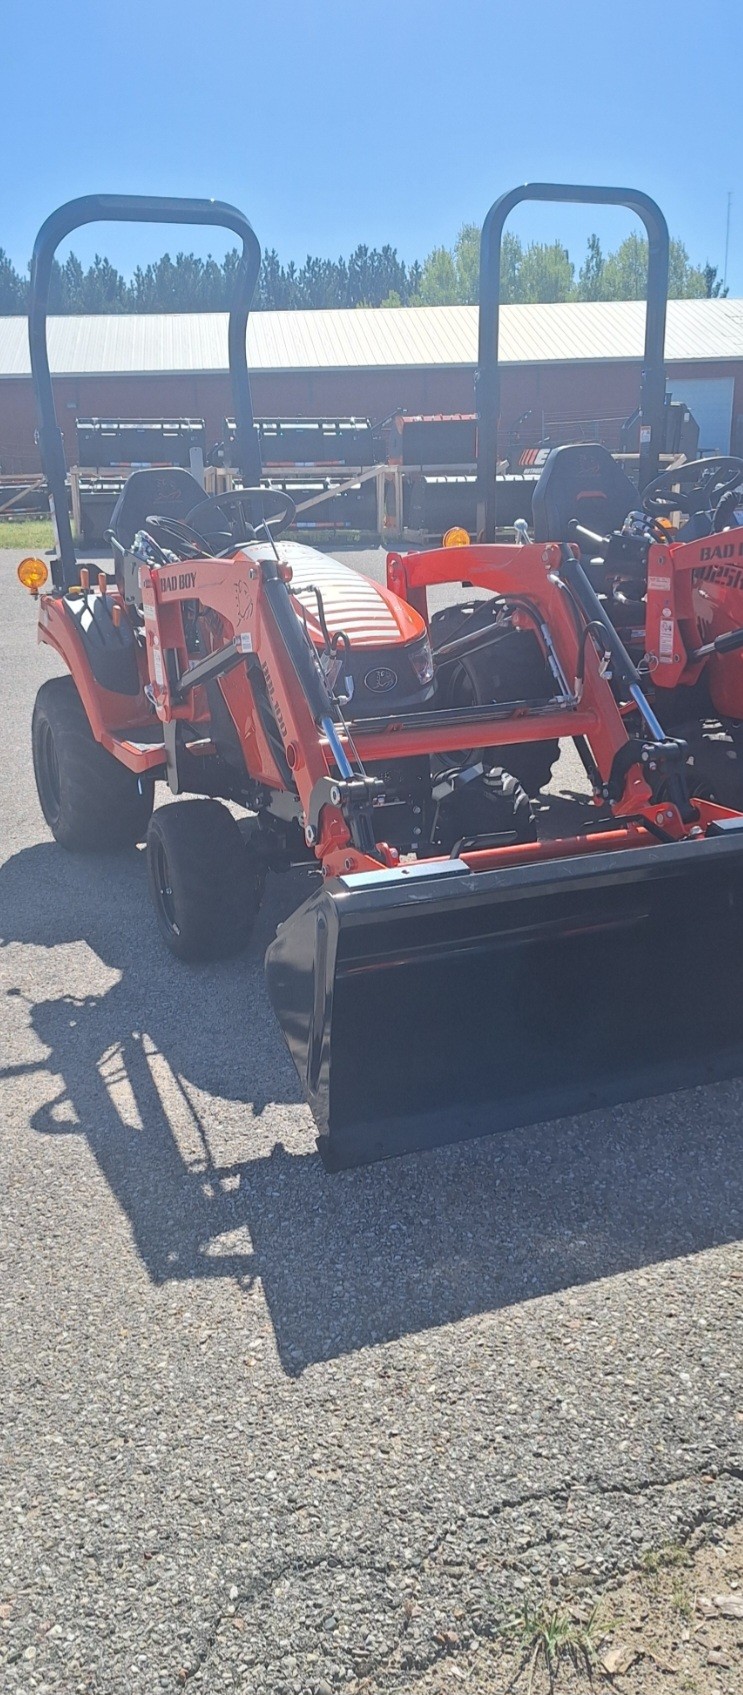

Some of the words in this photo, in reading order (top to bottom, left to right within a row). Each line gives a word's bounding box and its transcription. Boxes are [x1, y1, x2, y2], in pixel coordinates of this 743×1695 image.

[700, 543, 735, 561] BAD
[160, 576, 178, 593] BAD
[179, 572, 197, 590] BOY
